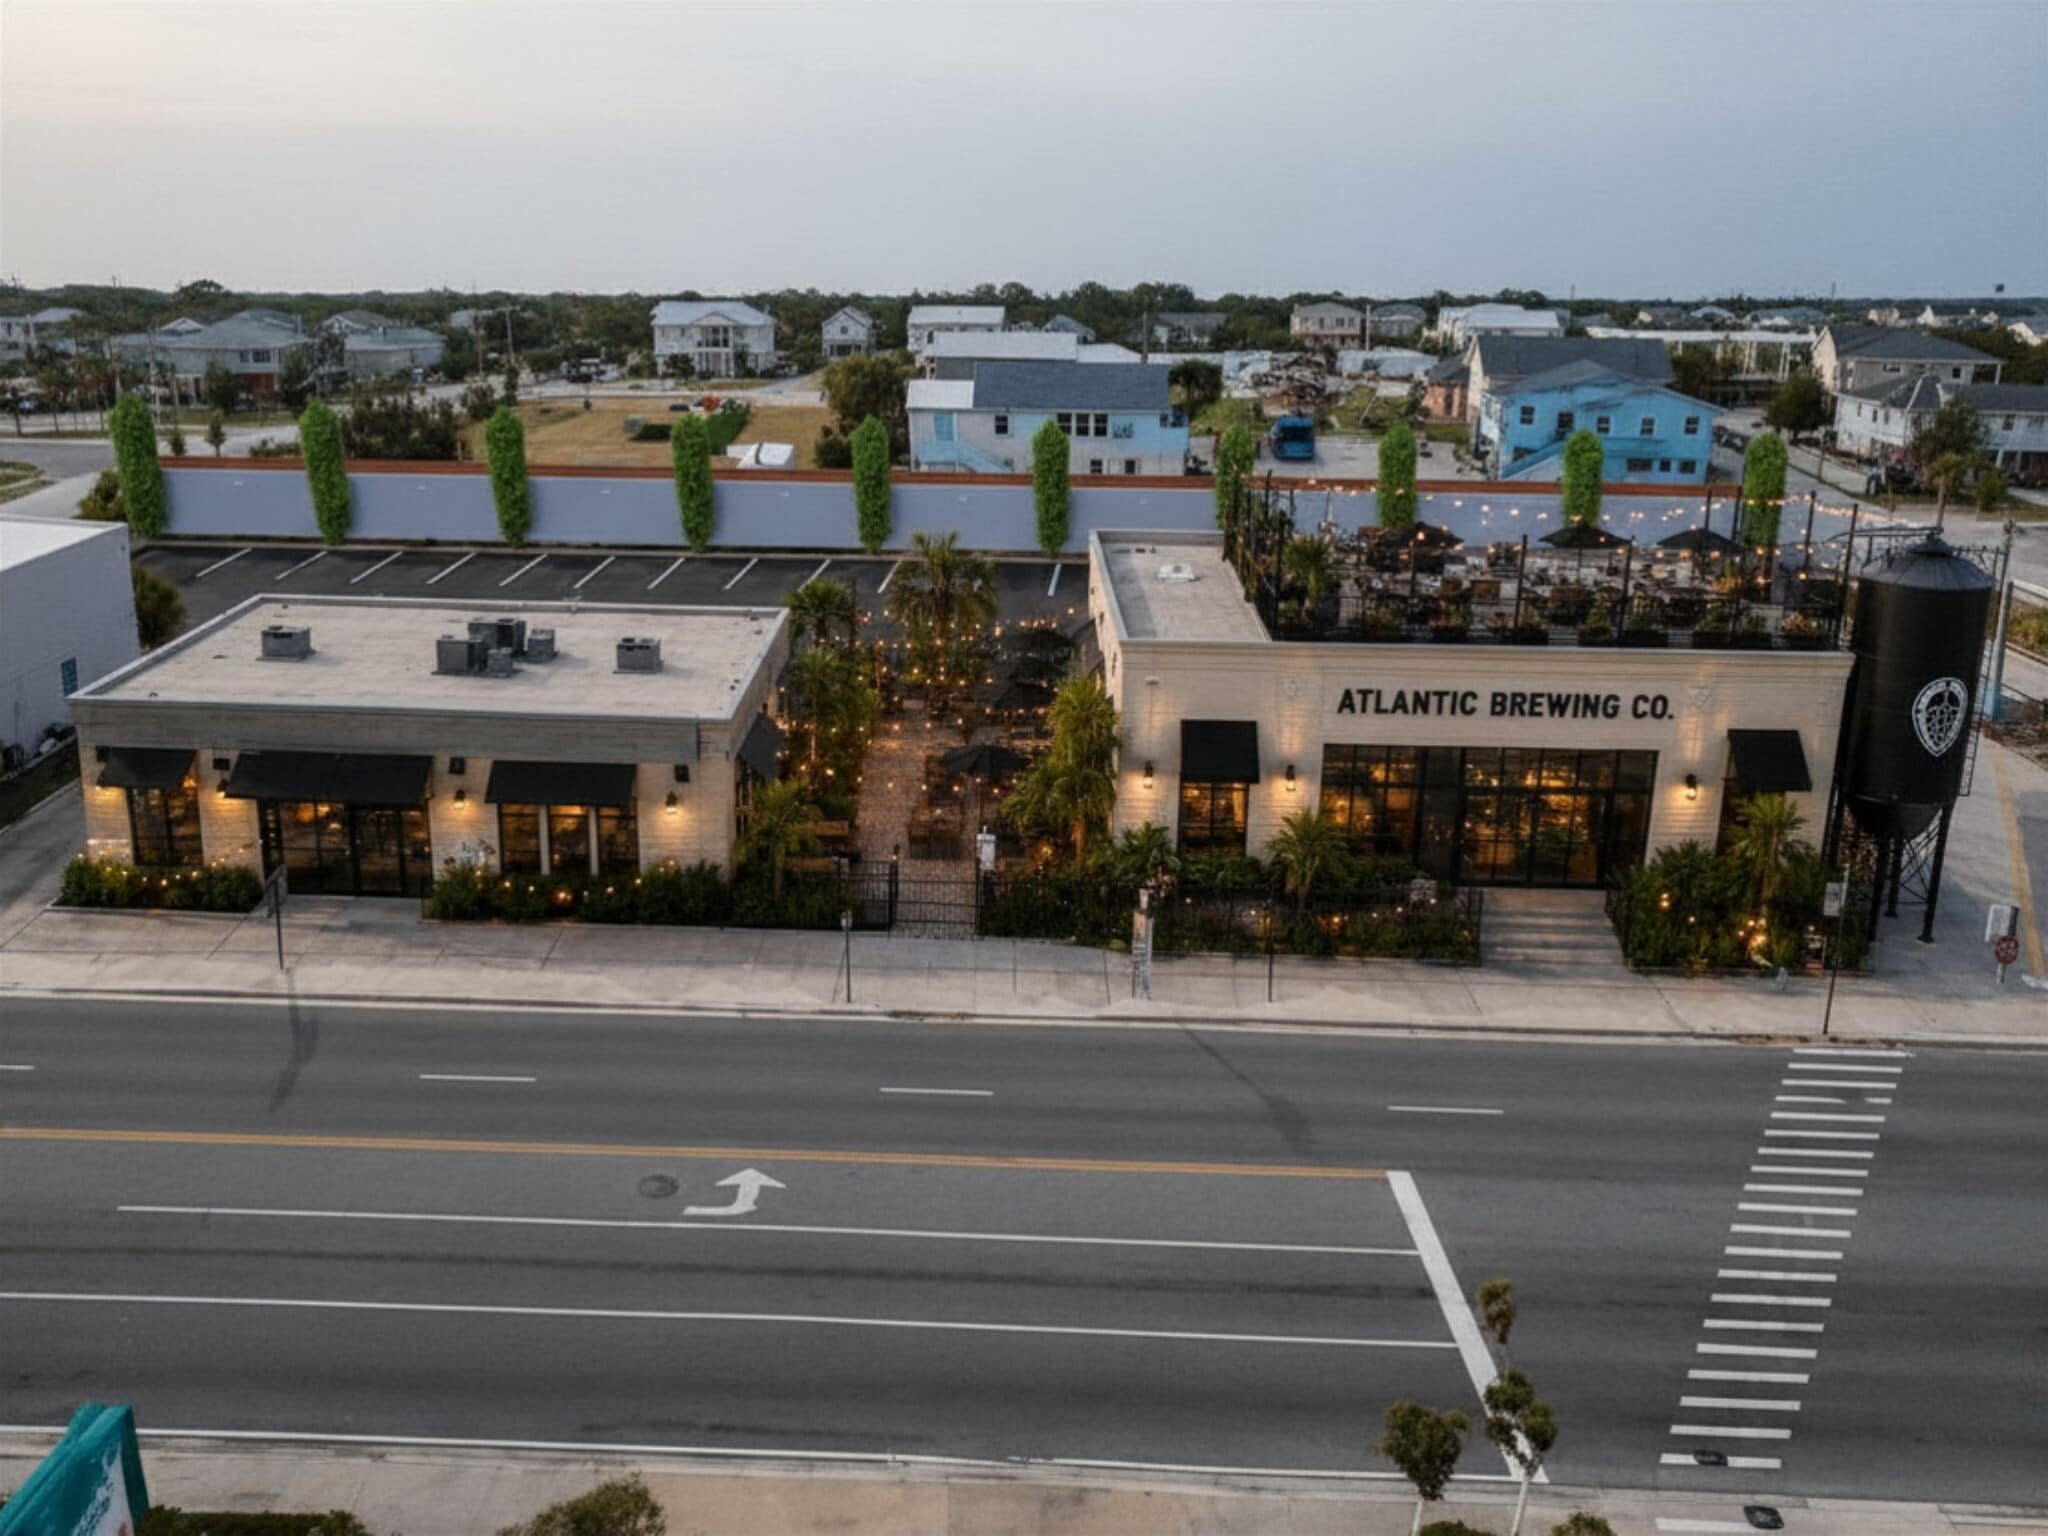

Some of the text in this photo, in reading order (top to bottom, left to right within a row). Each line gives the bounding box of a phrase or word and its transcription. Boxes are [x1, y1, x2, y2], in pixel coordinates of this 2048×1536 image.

[1337, 688, 1675, 720] ATLANTIC BREWING CO.
